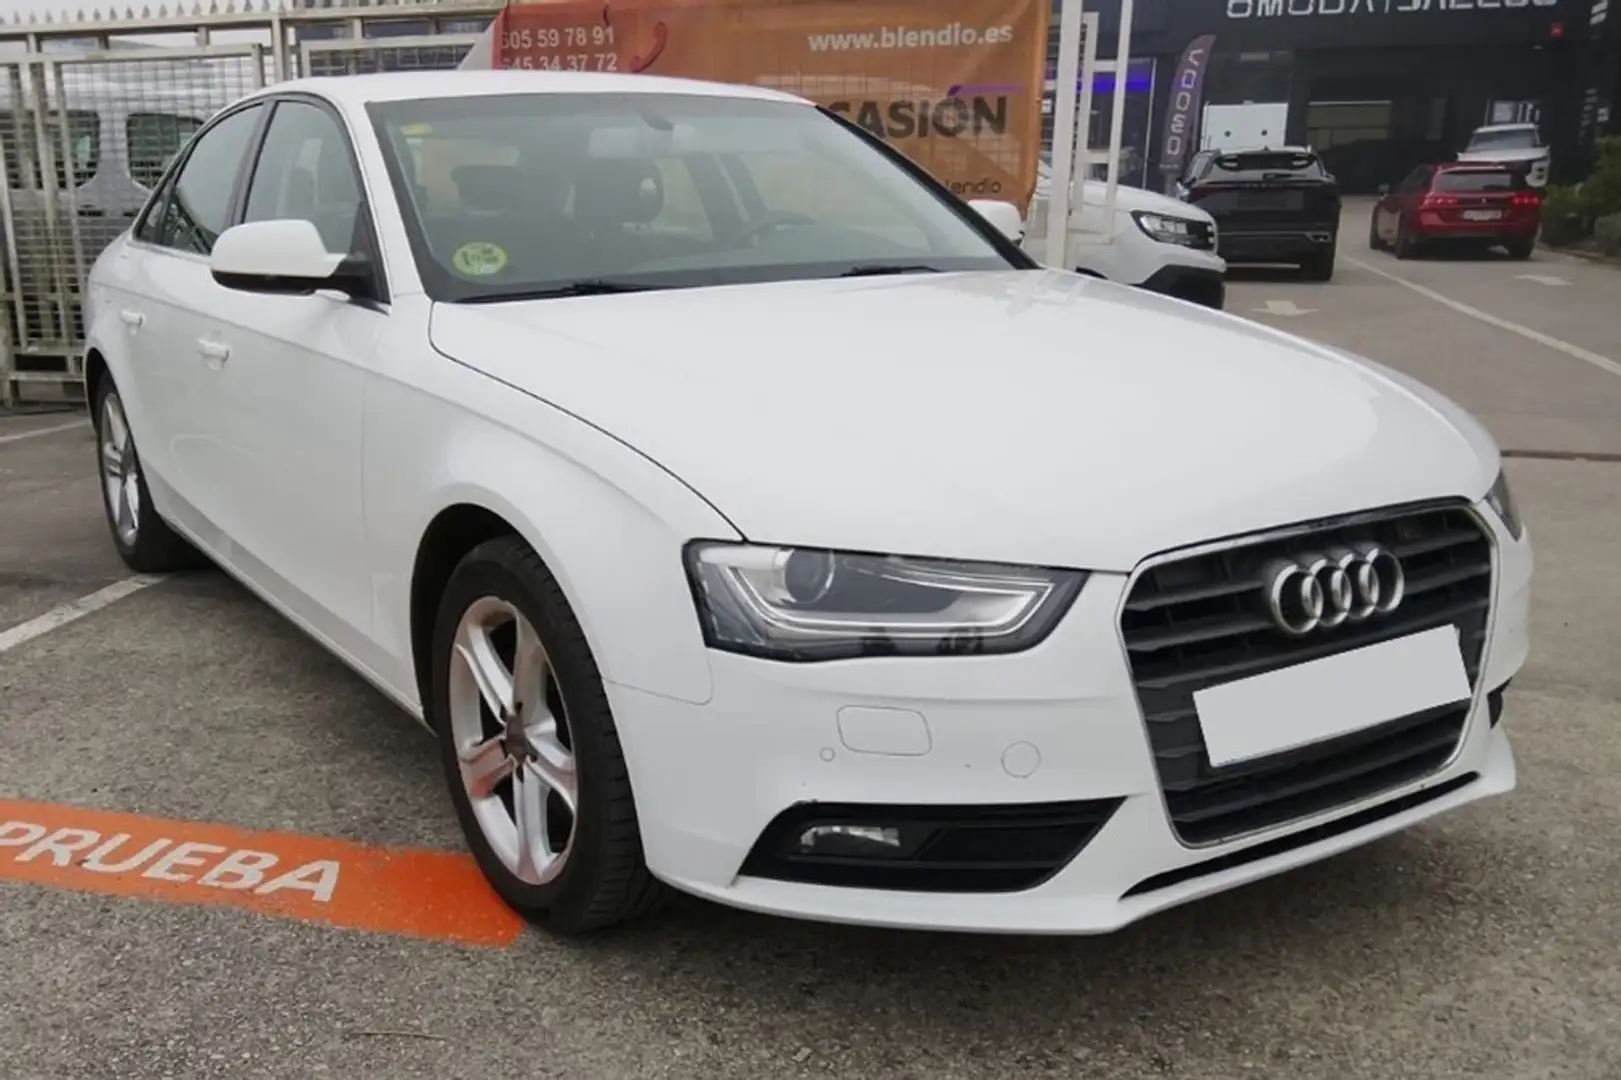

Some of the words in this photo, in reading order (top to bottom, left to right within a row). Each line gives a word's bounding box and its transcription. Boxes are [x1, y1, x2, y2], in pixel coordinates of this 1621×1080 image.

[537, 28, 560, 48] 59
[564, 26, 588, 47] 78
[592, 25, 615, 45] 91
[808, 22, 1014, 51] www.blendio.es
[594, 53, 618, 71] 72
[0, 821, 341, 902] PRUEBA
